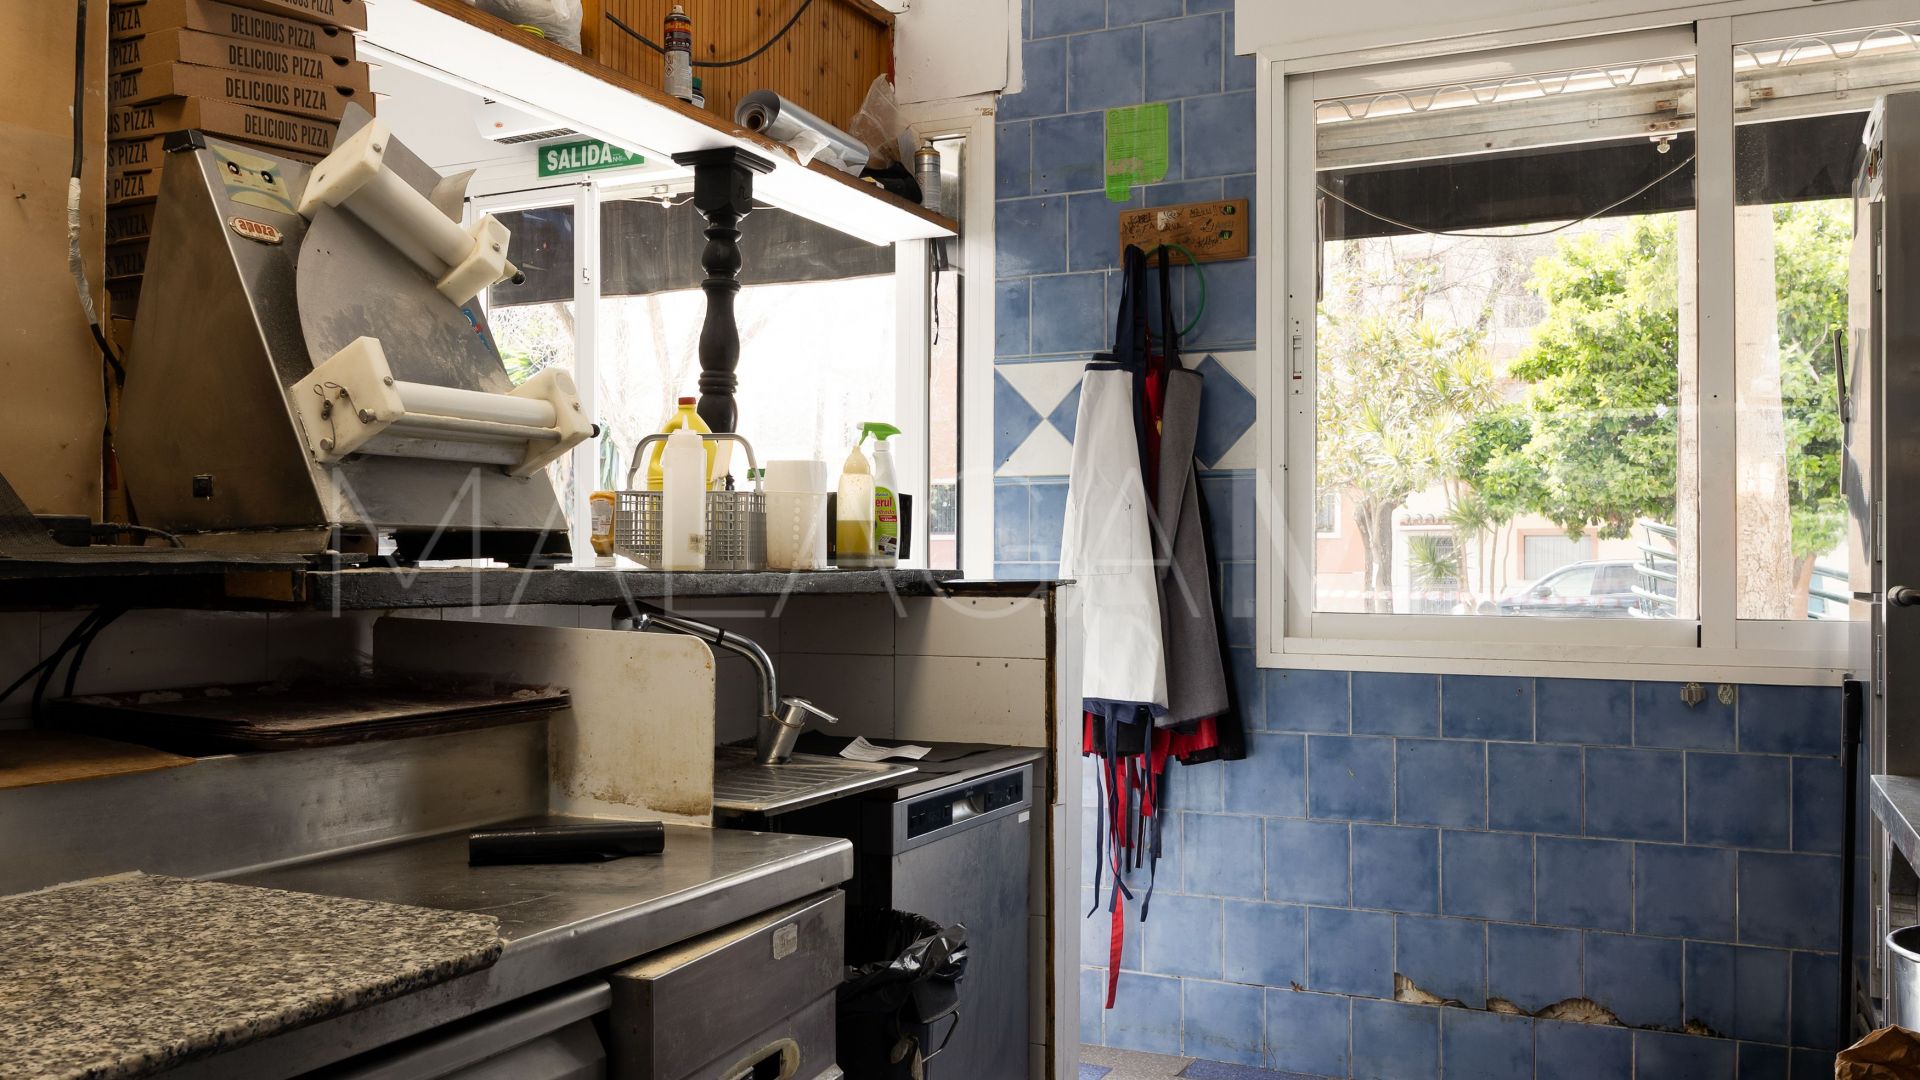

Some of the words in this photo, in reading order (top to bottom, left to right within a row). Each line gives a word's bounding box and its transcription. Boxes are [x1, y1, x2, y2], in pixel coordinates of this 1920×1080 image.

[110, 9, 141, 32] PIZZA
[231, 13, 285, 43] DELICIOUS
[288, 26, 316, 50] PIZZA
[113, 42, 140, 66] PIZZA
[228, 44, 289, 74] DELICIOUS
[292, 56, 324, 80] PIZZA
[114, 76, 138, 100] PIZZA
[225, 77, 289, 106] DELICIOUS
[294, 87, 327, 111] PIZZA
[123, 108, 155, 132] PIZZA
[244, 113, 298, 143] DELICIOUS
[301, 125, 329, 149] PIZZA
[118, 143, 148, 167] PIZZA
[547, 143, 612, 171] SALIDA
[114, 176, 144, 199] PIZZA
